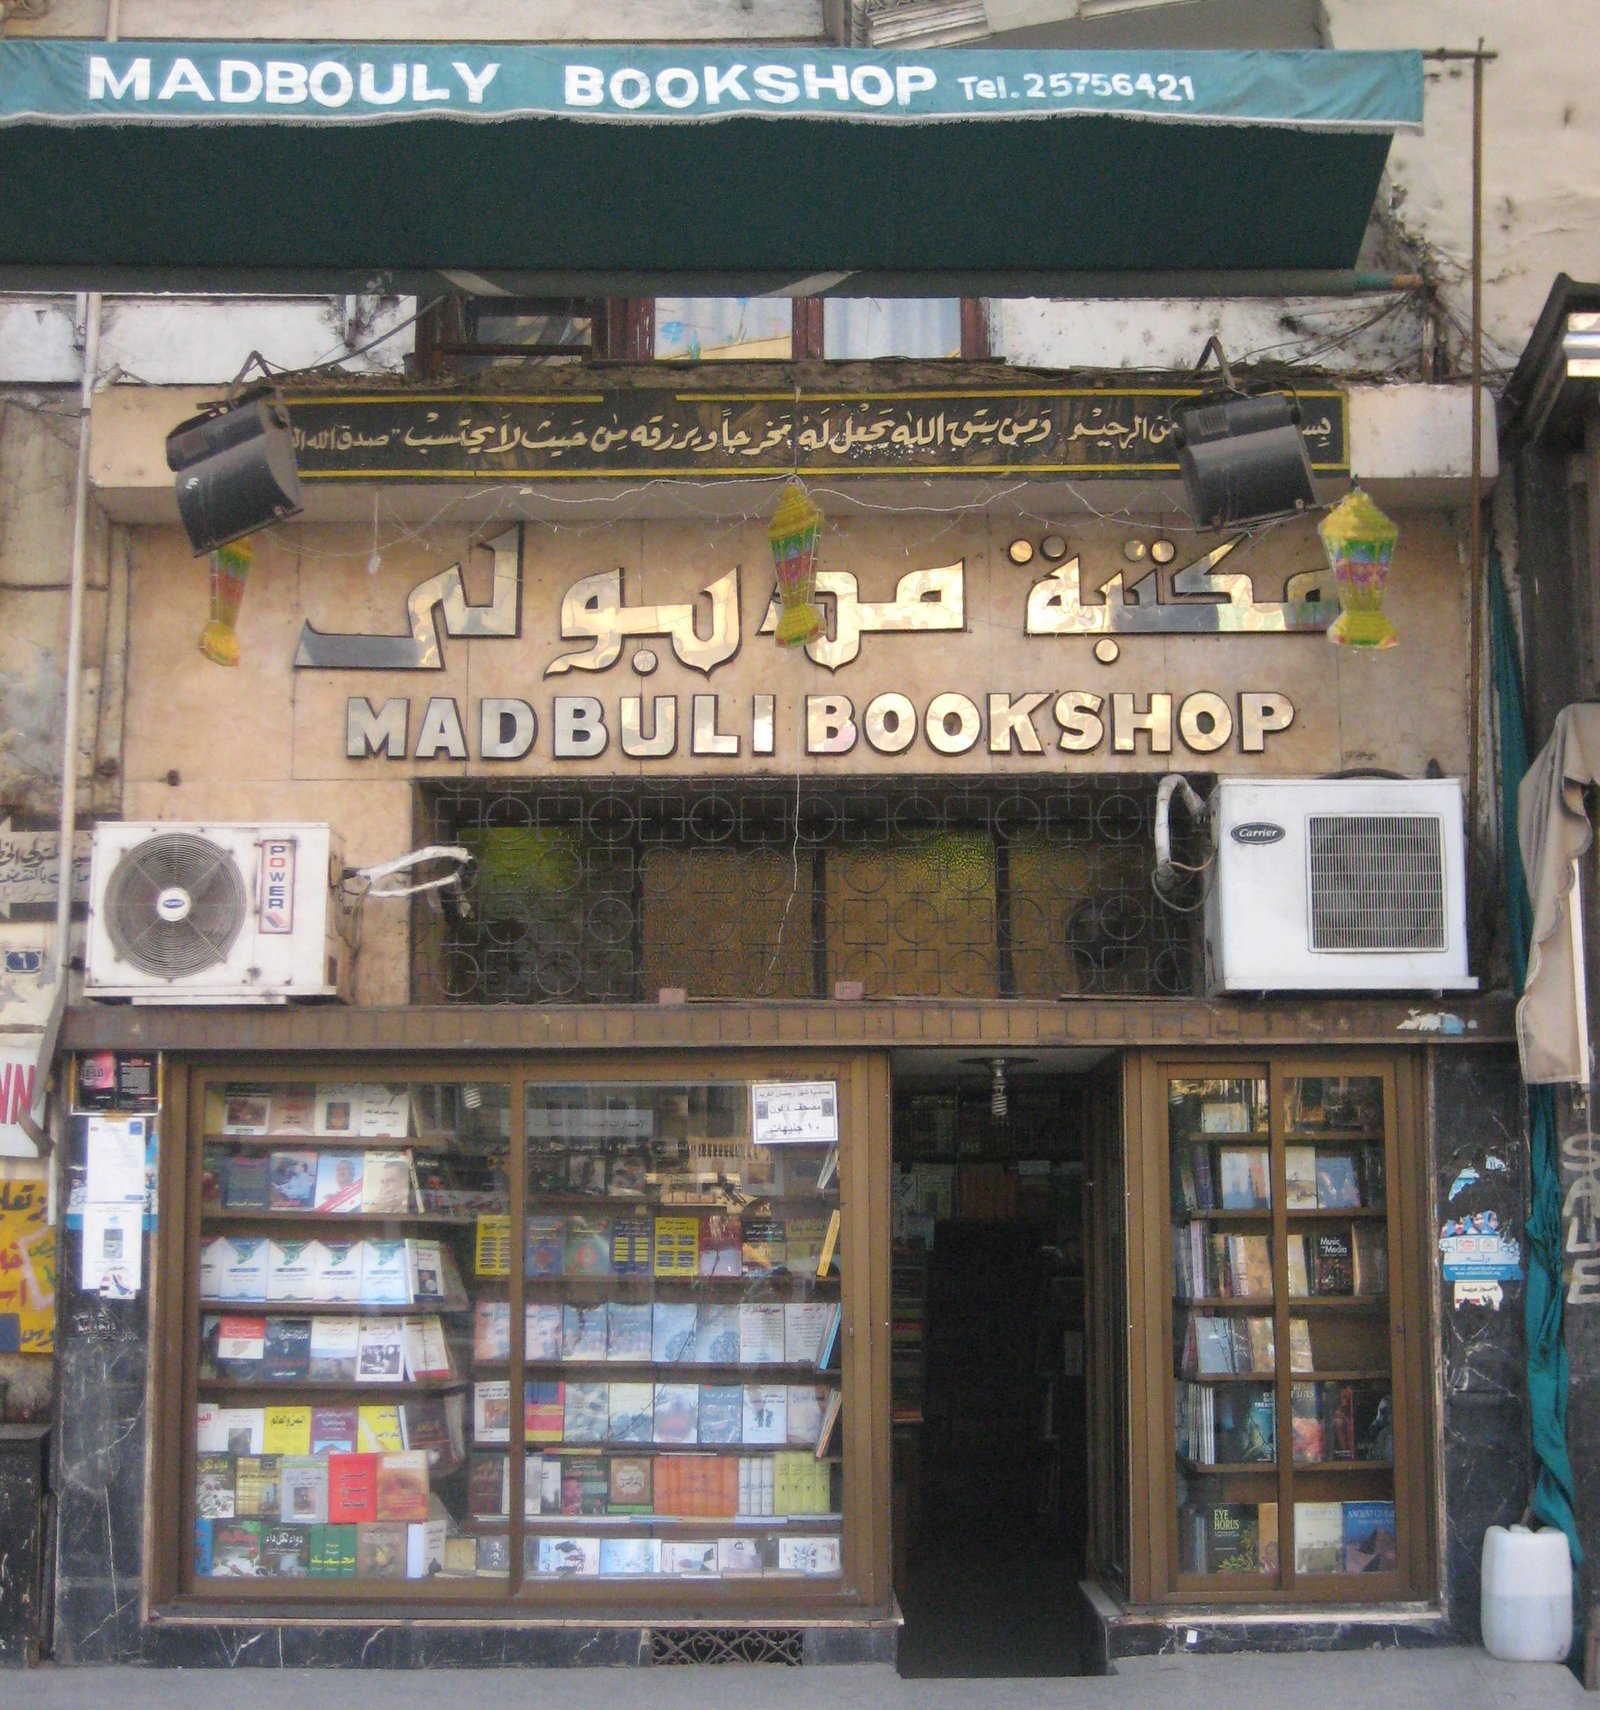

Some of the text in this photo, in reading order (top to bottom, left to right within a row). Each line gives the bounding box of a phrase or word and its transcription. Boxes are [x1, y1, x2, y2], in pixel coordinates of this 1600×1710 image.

[89, 57, 500, 108] MADBOULY
[564, 64, 937, 110] BOOKSHOP
[1008, 533, 1341, 665] مكتبة
[344, 690, 1296, 761] MADBULI BOOKSHOP
[1238, 827, 1278, 839] Carrier
[1213, 1509, 1229, 1520] EYE
[1214, 1520, 1240, 1530] HORUS
